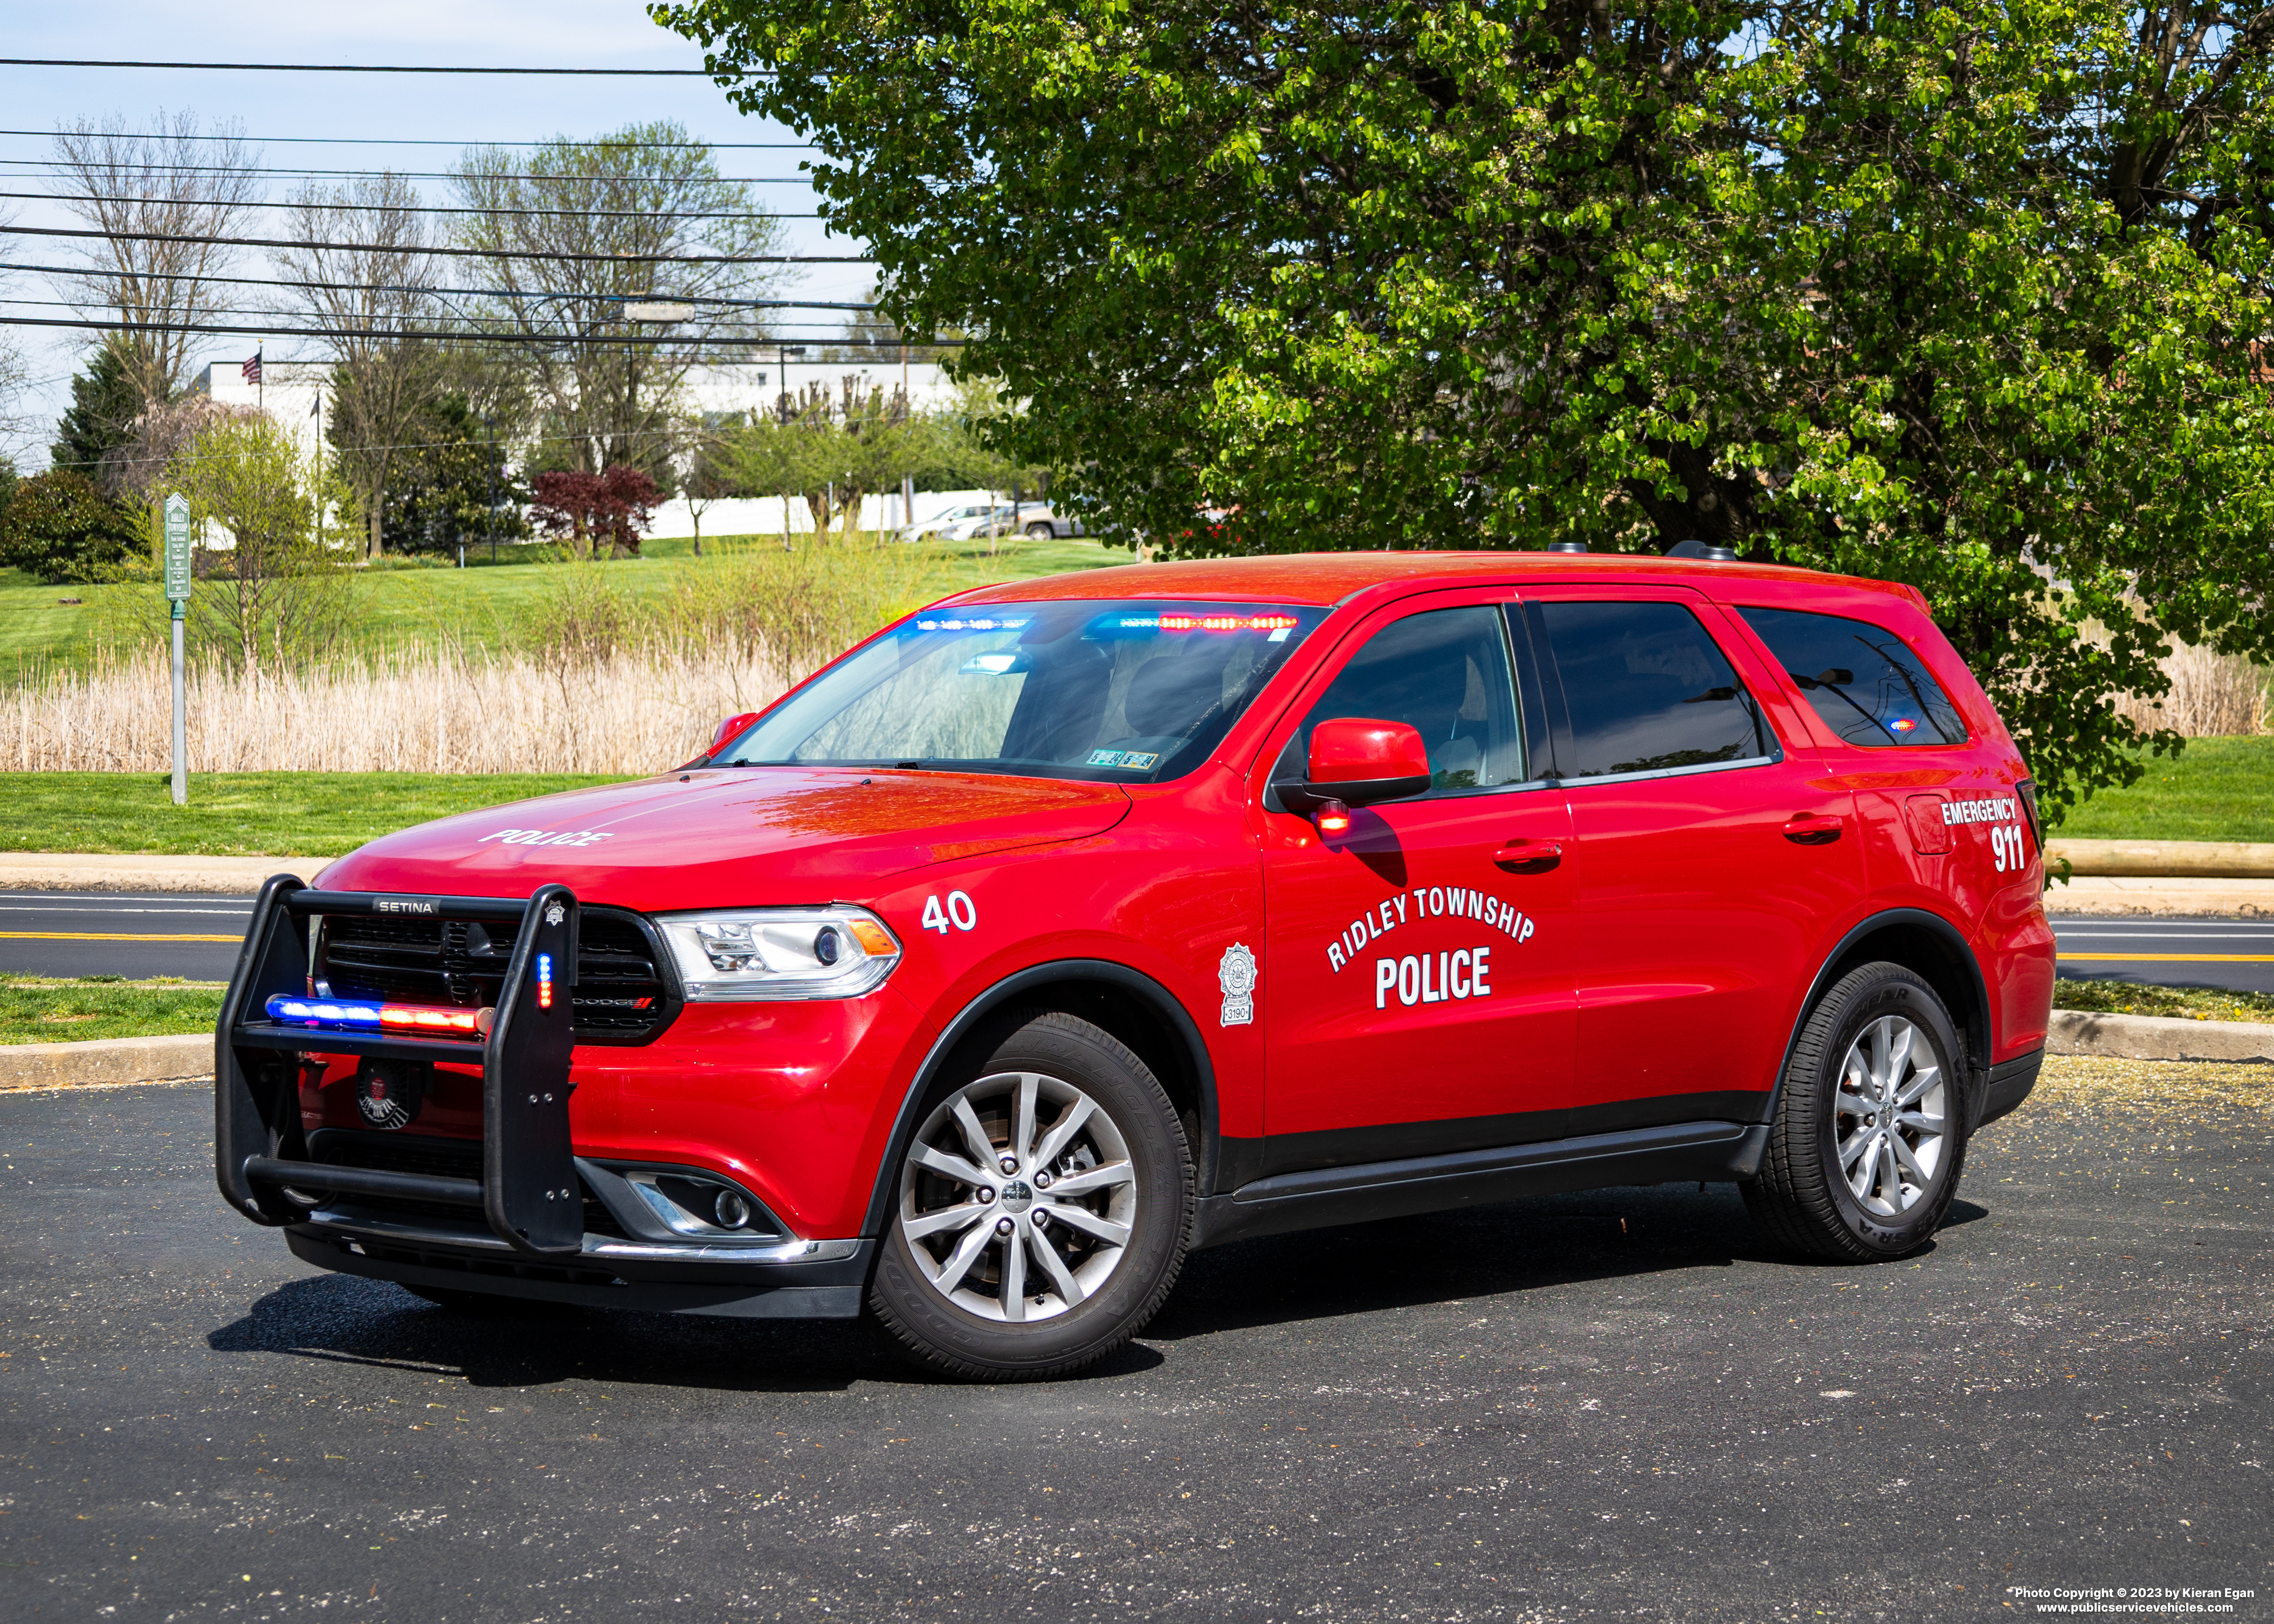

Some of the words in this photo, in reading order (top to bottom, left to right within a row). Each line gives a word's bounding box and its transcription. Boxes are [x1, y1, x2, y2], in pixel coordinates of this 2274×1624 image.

[1091, 754, 1100, 763] 5
[1108, 753, 1122, 764] 24
[1124, 756, 1133, 765] 5
[1141, 755, 1155, 767] 24
[1941, 798, 2016, 826] EMERGENCY
[477, 829, 616, 847] POLICE
[1991, 825, 2024, 873] 911
[379, 902, 432, 913] SETINA
[921, 889, 977, 935] 40
[1326, 893, 1406, 974] RIDLEY
[1413, 886, 1534, 944] TOWNSHIP
[1375, 946, 1491, 1010] POLICE
[1229, 984, 1247, 994] POLICE
[572, 998, 642, 1006] DODGE
[1228, 1007, 1245, 1019] 3190
